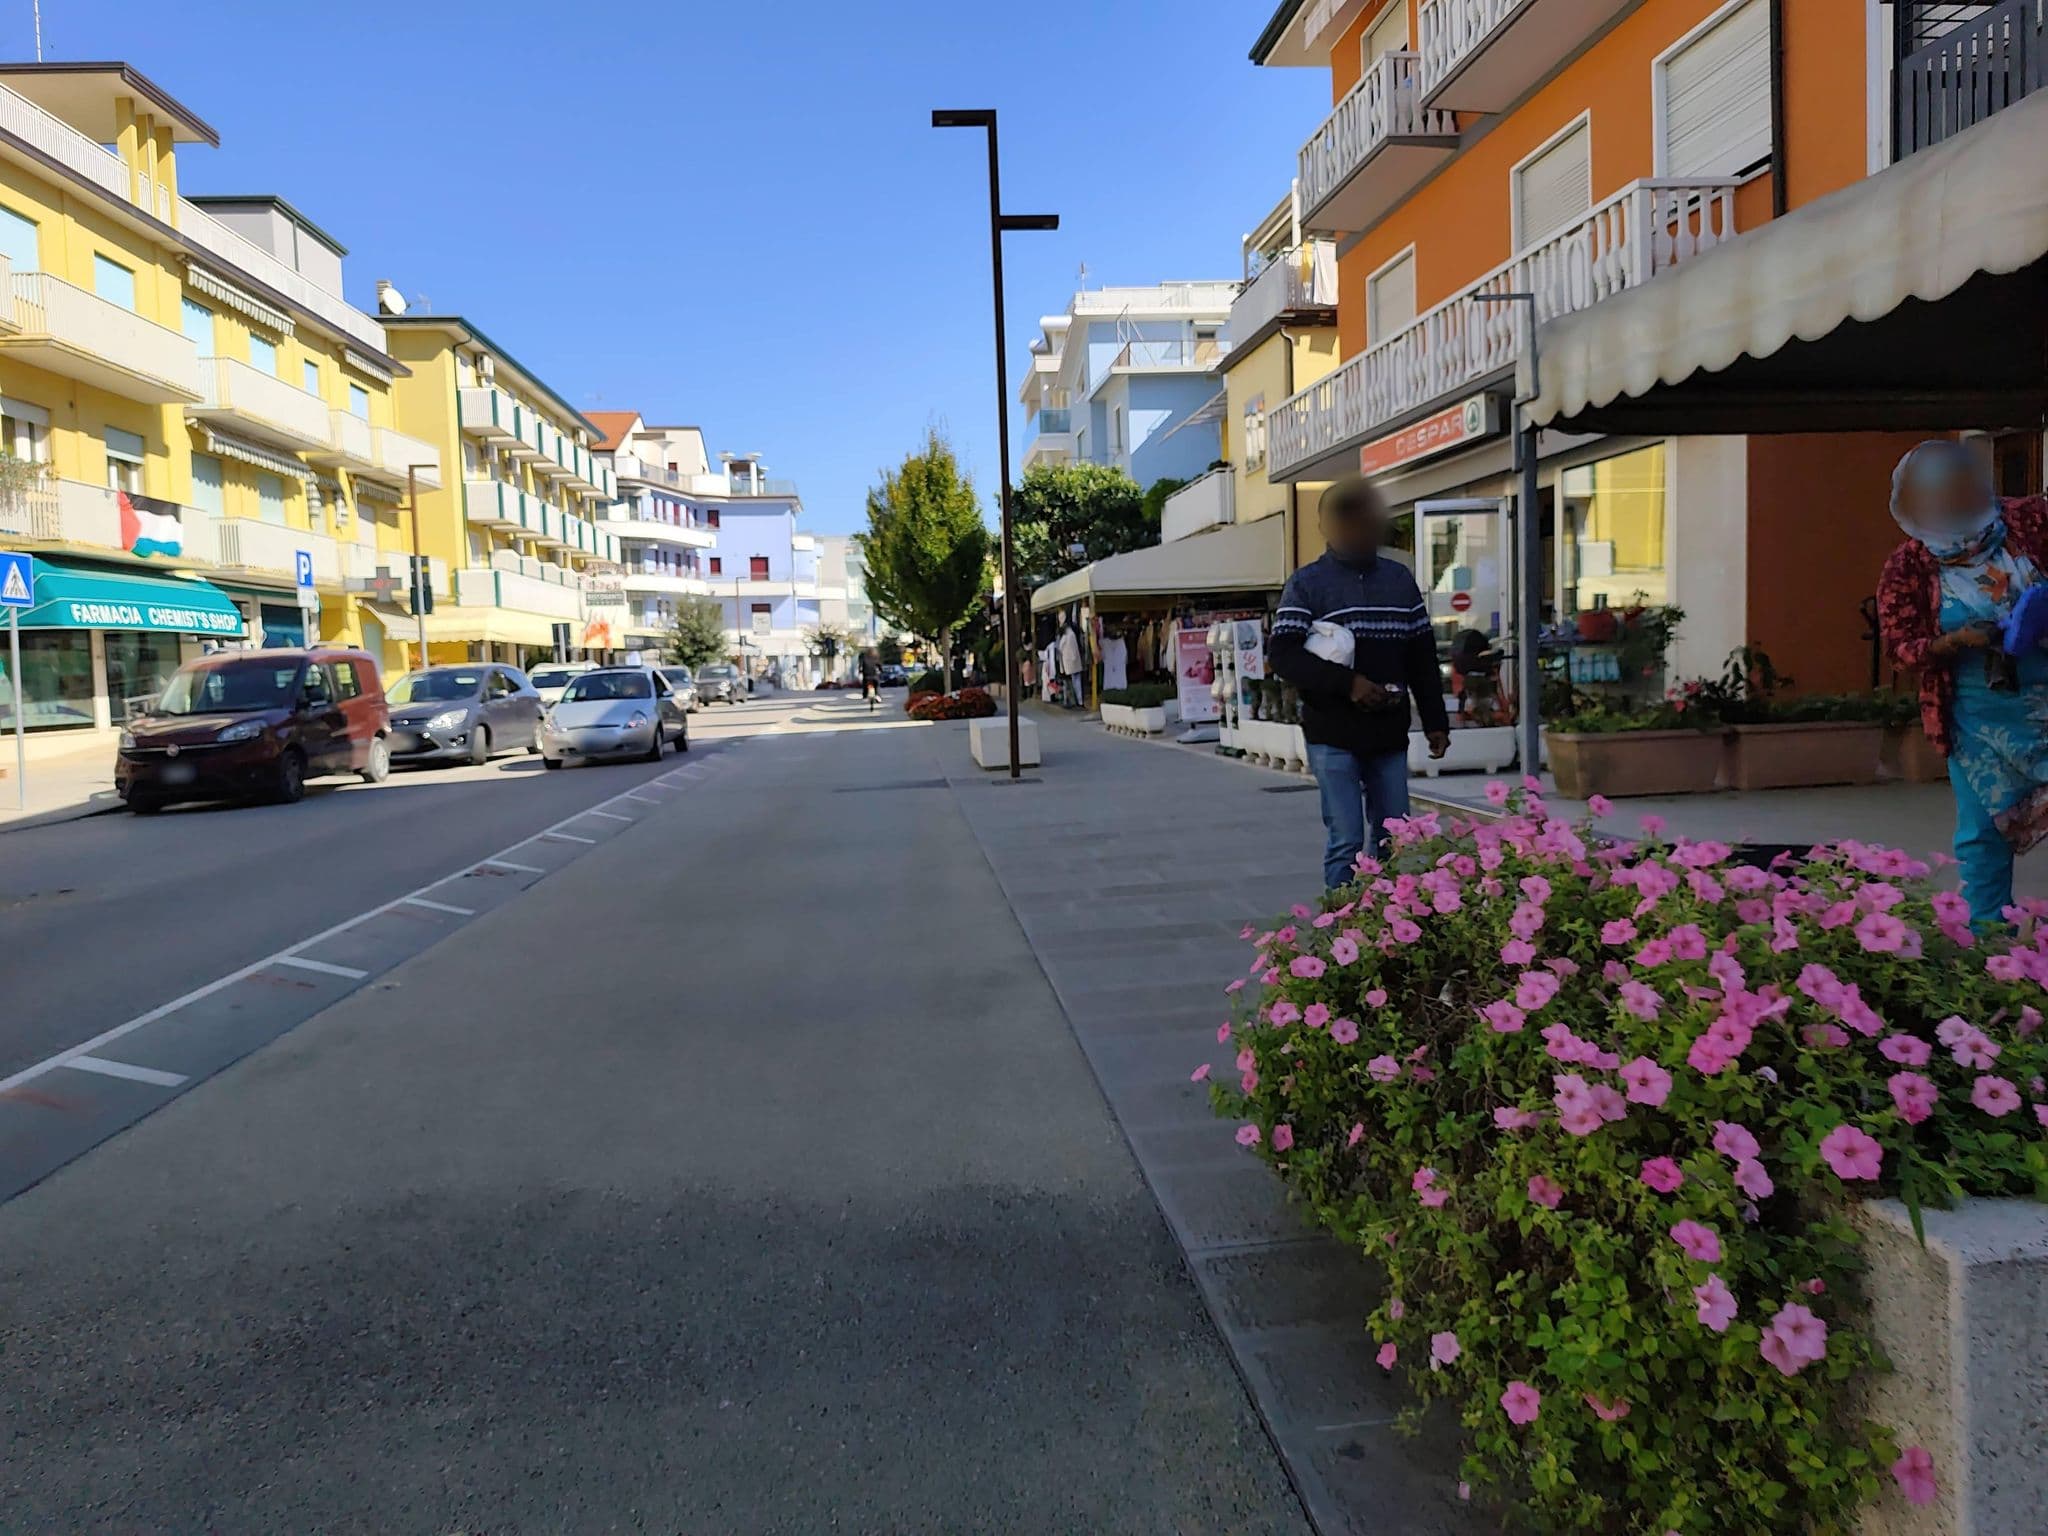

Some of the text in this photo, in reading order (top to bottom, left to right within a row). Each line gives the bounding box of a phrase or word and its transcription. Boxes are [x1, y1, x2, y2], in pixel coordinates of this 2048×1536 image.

[1395, 413, 1464, 456] DESPAR
[300, 554, 310, 584] P
[70, 603, 238, 631] FARMACIA CHEMIST'S SHOP
